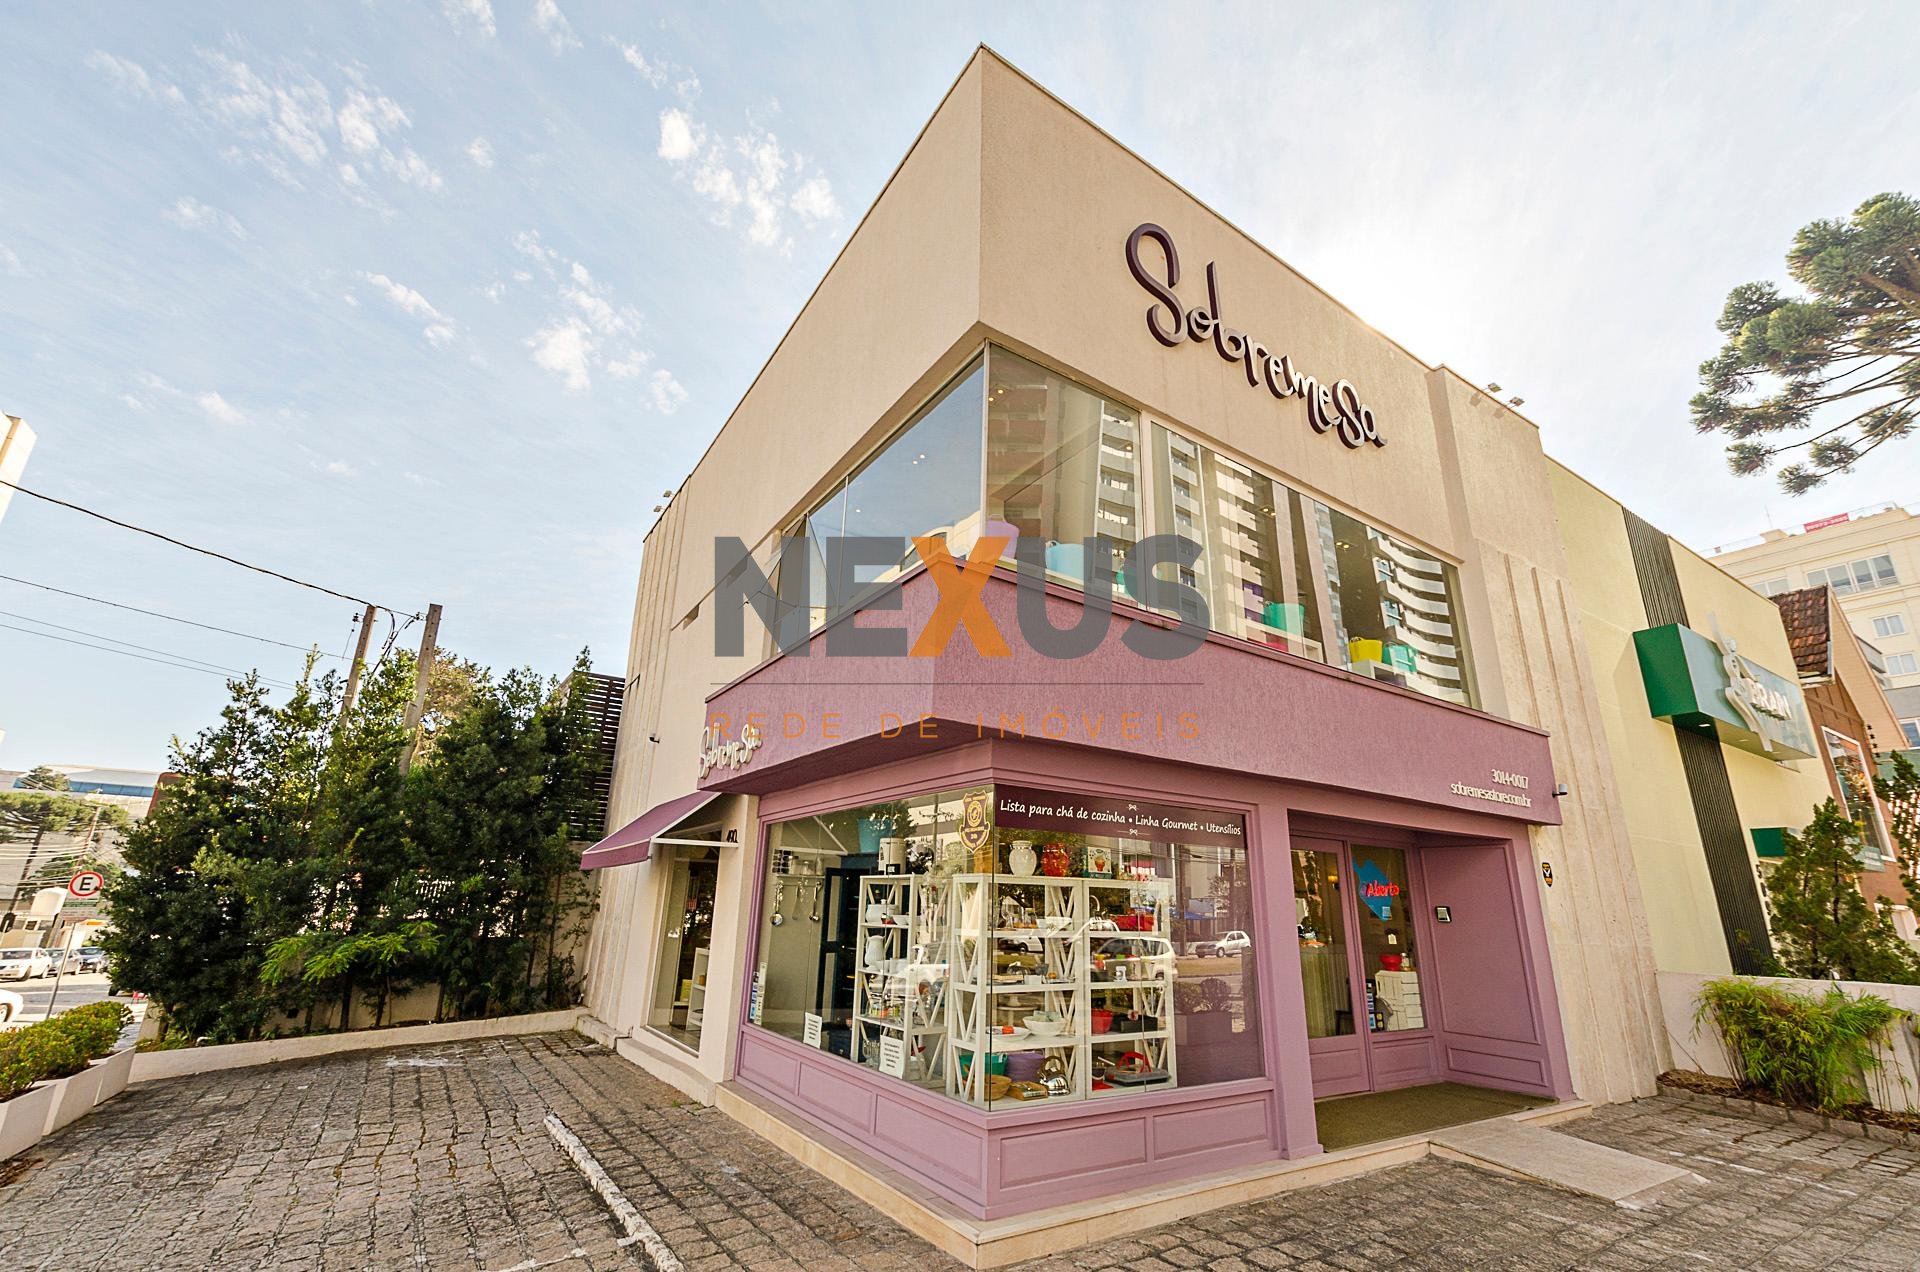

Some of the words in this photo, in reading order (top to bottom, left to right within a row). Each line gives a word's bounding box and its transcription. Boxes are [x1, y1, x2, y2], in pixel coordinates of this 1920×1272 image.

[1000, 799, 1025, 813] Lista
[1029, 805, 1053, 817] para
[1056, 805, 1073, 818] chá
[1077, 807, 1088, 819] de
[1092, 811, 1126, 824] cozinha
[1135, 814, 1159, 827] Linha
[1162, 818, 1198, 831] Gourmet
[1206, 823, 1241, 835] Utensílios
[79, 877, 93, 891] E
